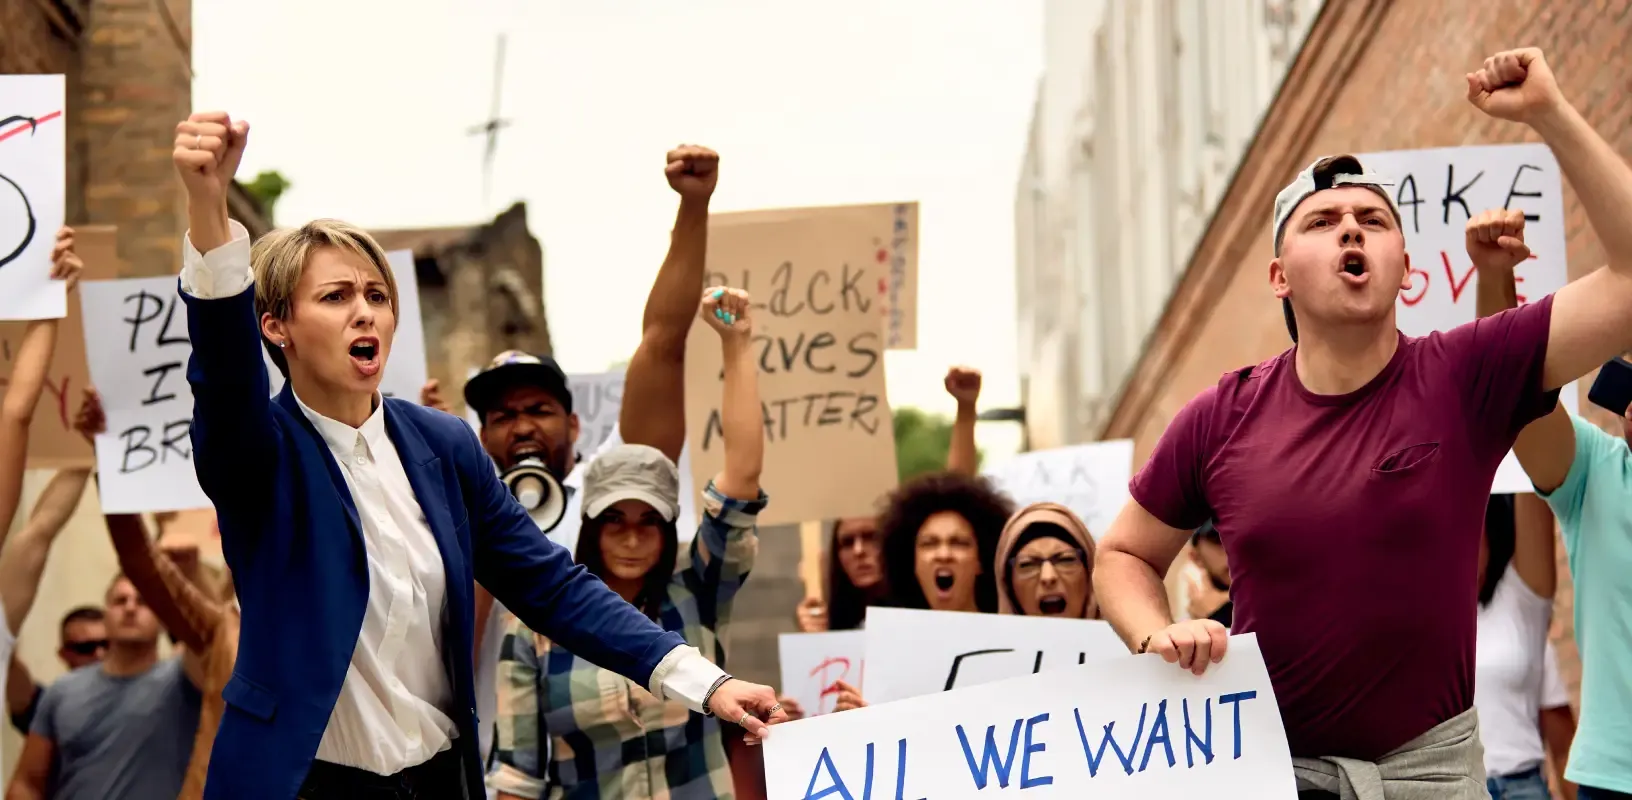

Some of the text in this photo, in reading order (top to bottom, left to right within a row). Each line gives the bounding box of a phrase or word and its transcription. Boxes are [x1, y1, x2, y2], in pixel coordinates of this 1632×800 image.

[1397, 163, 1543, 234] AKE
[141, 361, 183, 406] I
[719, 326, 878, 380] ives
[955, 712, 1054, 790] WE
[1074, 690, 1257, 778] WANT
